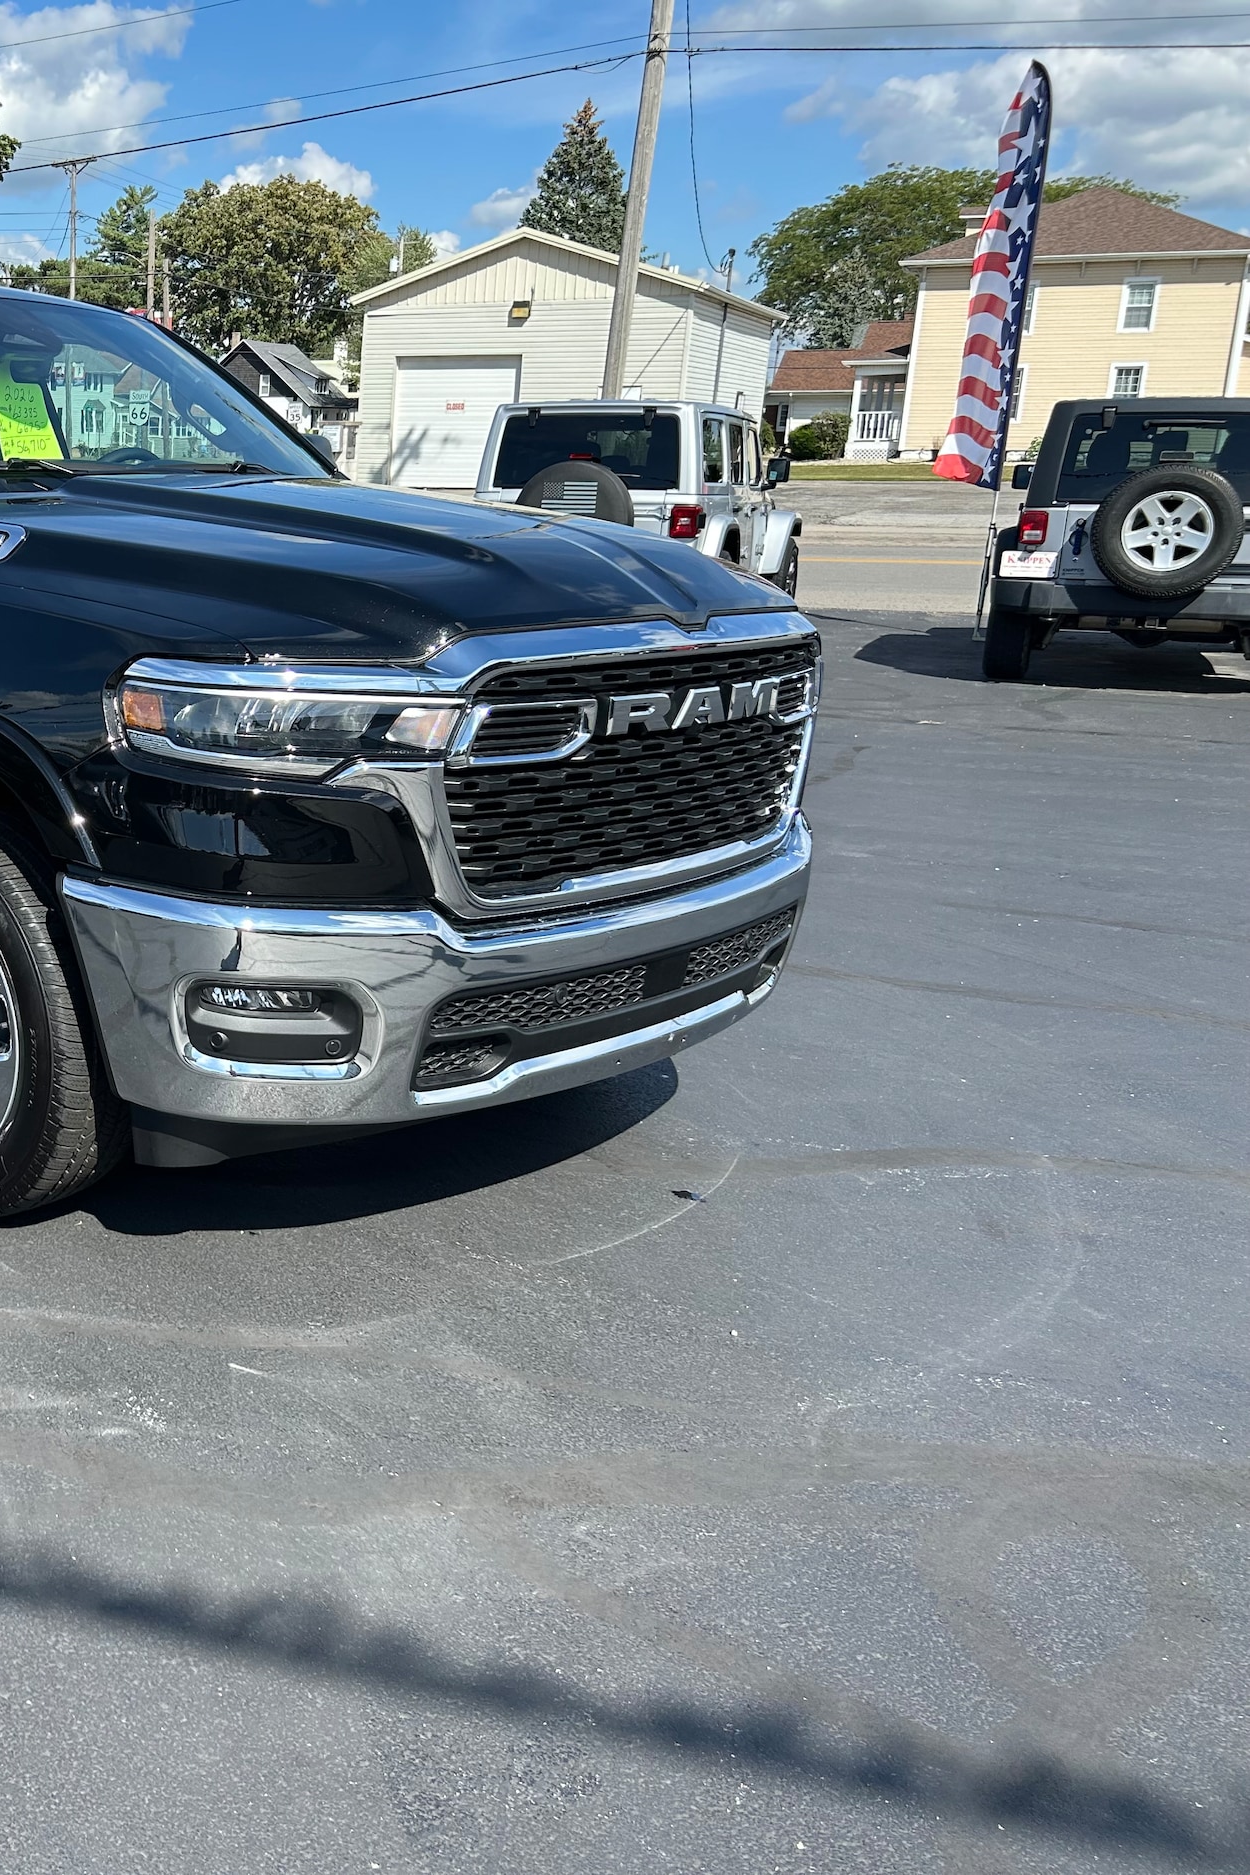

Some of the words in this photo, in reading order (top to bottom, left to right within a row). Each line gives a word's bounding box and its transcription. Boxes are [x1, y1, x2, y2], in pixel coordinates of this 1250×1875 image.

[4, 385, 35, 403] 2026
[446, 402, 465, 411] CLOSED
[131, 407, 148, 420] 66
[290, 413, 301, 422] 35
[606, 680, 778, 737] RAM
